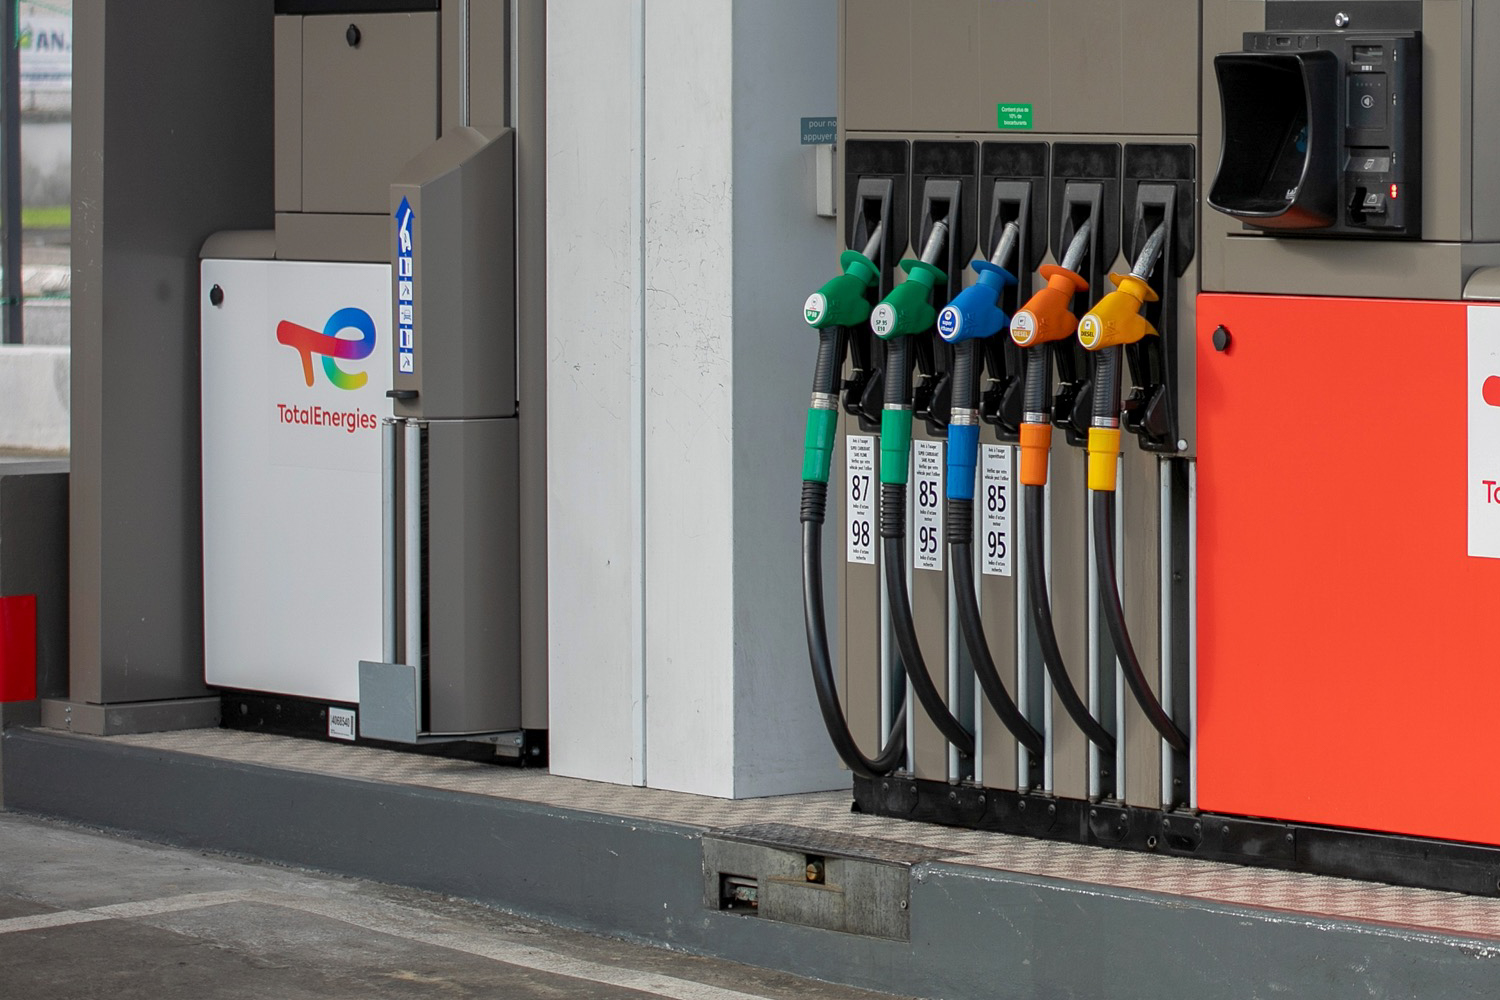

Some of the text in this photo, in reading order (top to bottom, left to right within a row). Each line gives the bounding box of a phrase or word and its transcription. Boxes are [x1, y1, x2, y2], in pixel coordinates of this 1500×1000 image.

[803, 132, 832, 142] appuyer
[808, 120, 826, 130] pour
[277, 404, 377, 433] TotalEnergies
[852, 475, 869, 501] 87
[919, 480, 937, 508] 85
[987, 484, 1006, 512] 85
[852, 520, 870, 547] 98
[919, 526, 937, 554] 95
[987, 531, 1006, 559] 95
